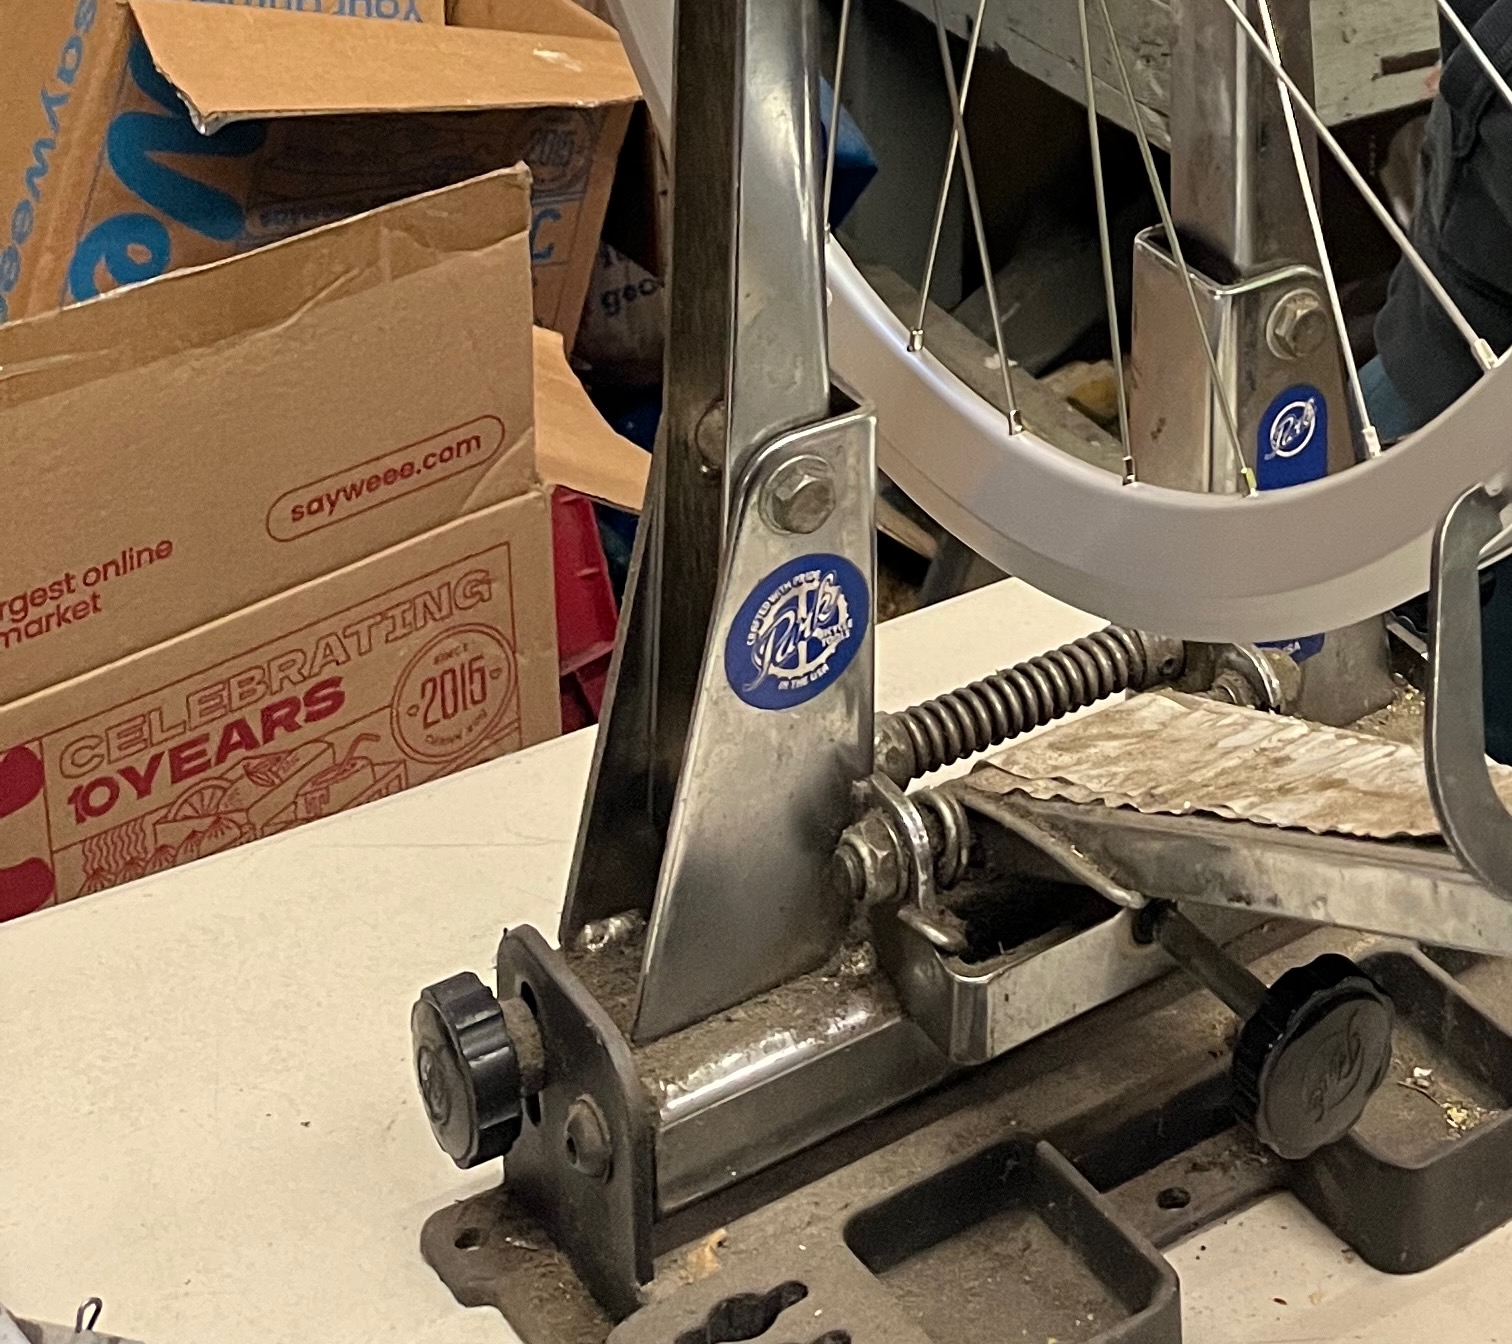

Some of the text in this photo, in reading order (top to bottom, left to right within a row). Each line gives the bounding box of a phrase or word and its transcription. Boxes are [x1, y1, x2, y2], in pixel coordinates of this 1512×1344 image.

[290, 430, 483, 525] sayweee.com
[83, 540, 173, 587] online
[58, 568, 496, 779] CELEBRATING
